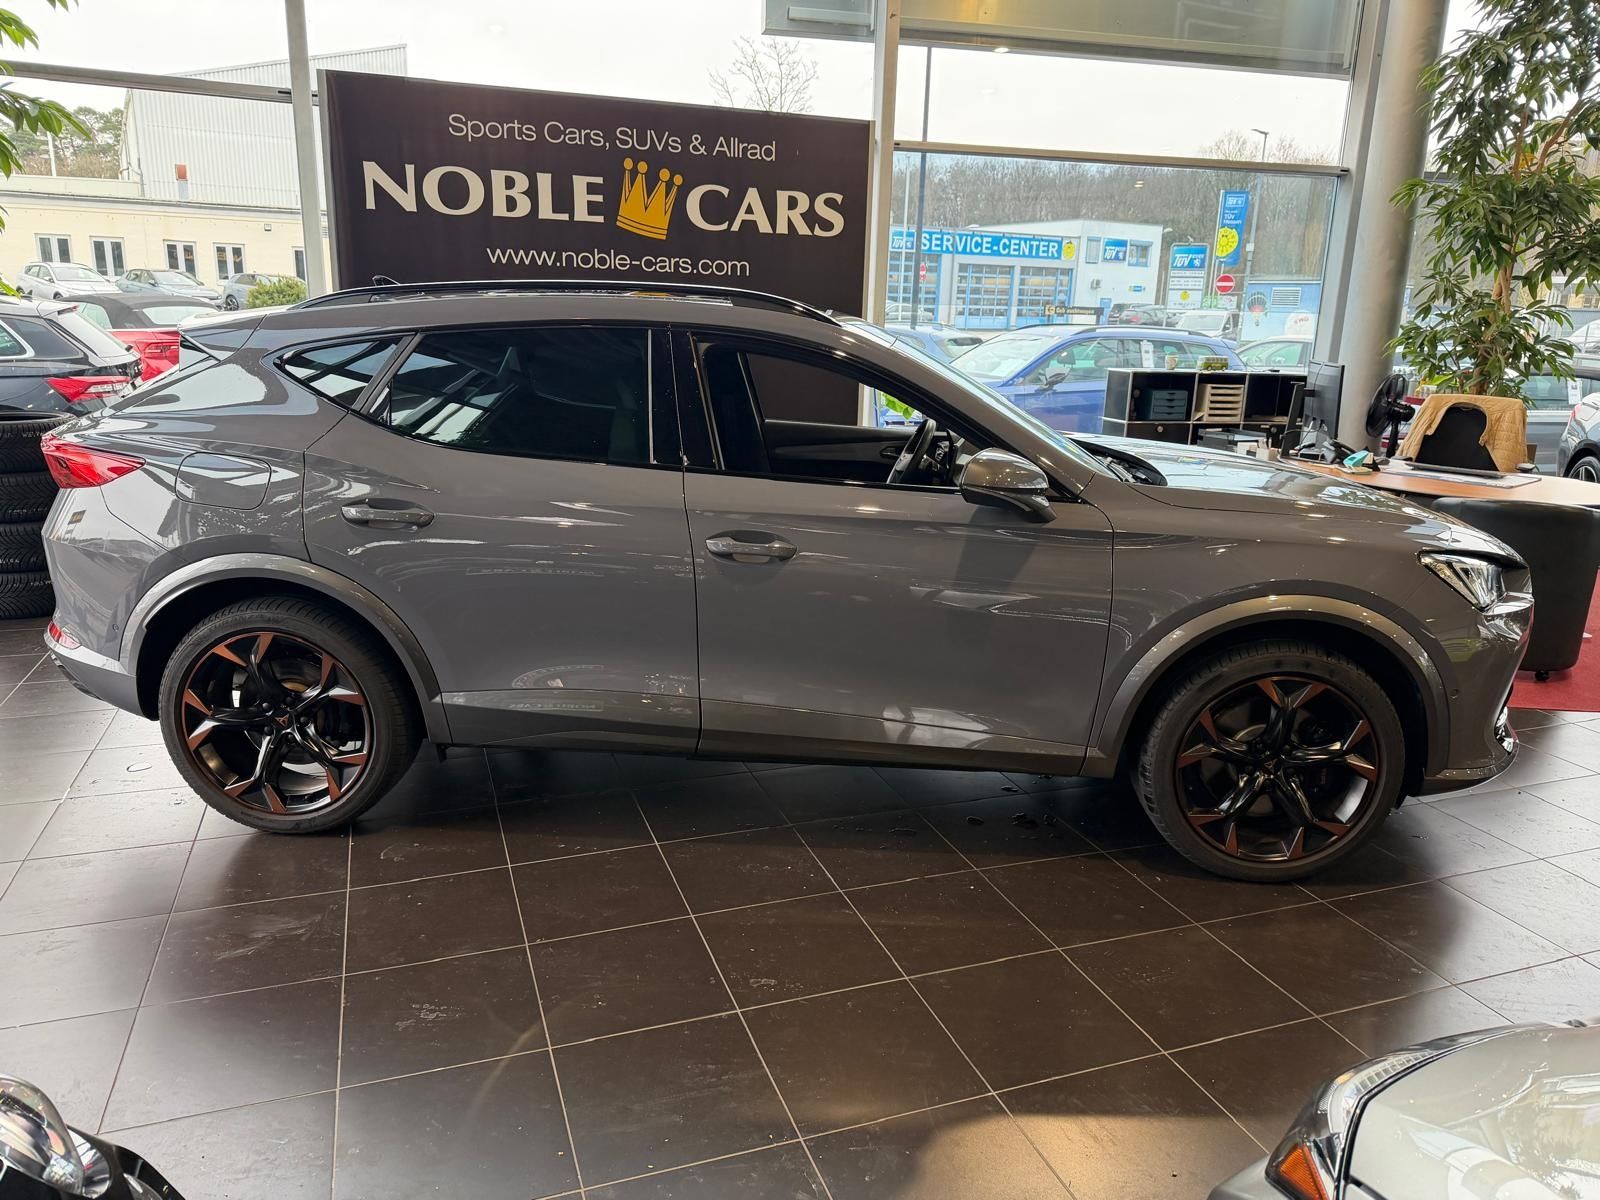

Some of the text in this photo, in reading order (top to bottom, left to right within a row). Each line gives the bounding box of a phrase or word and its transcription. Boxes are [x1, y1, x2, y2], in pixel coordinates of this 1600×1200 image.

[448, 113, 776, 162] Sports Cars, SUVs & Allrad
[362, 160, 845, 237] NOBLE CARS
[486, 247, 750, 277] www.noble-cars.com
[920, 232, 1059, 258] SERVICE-CENTER
